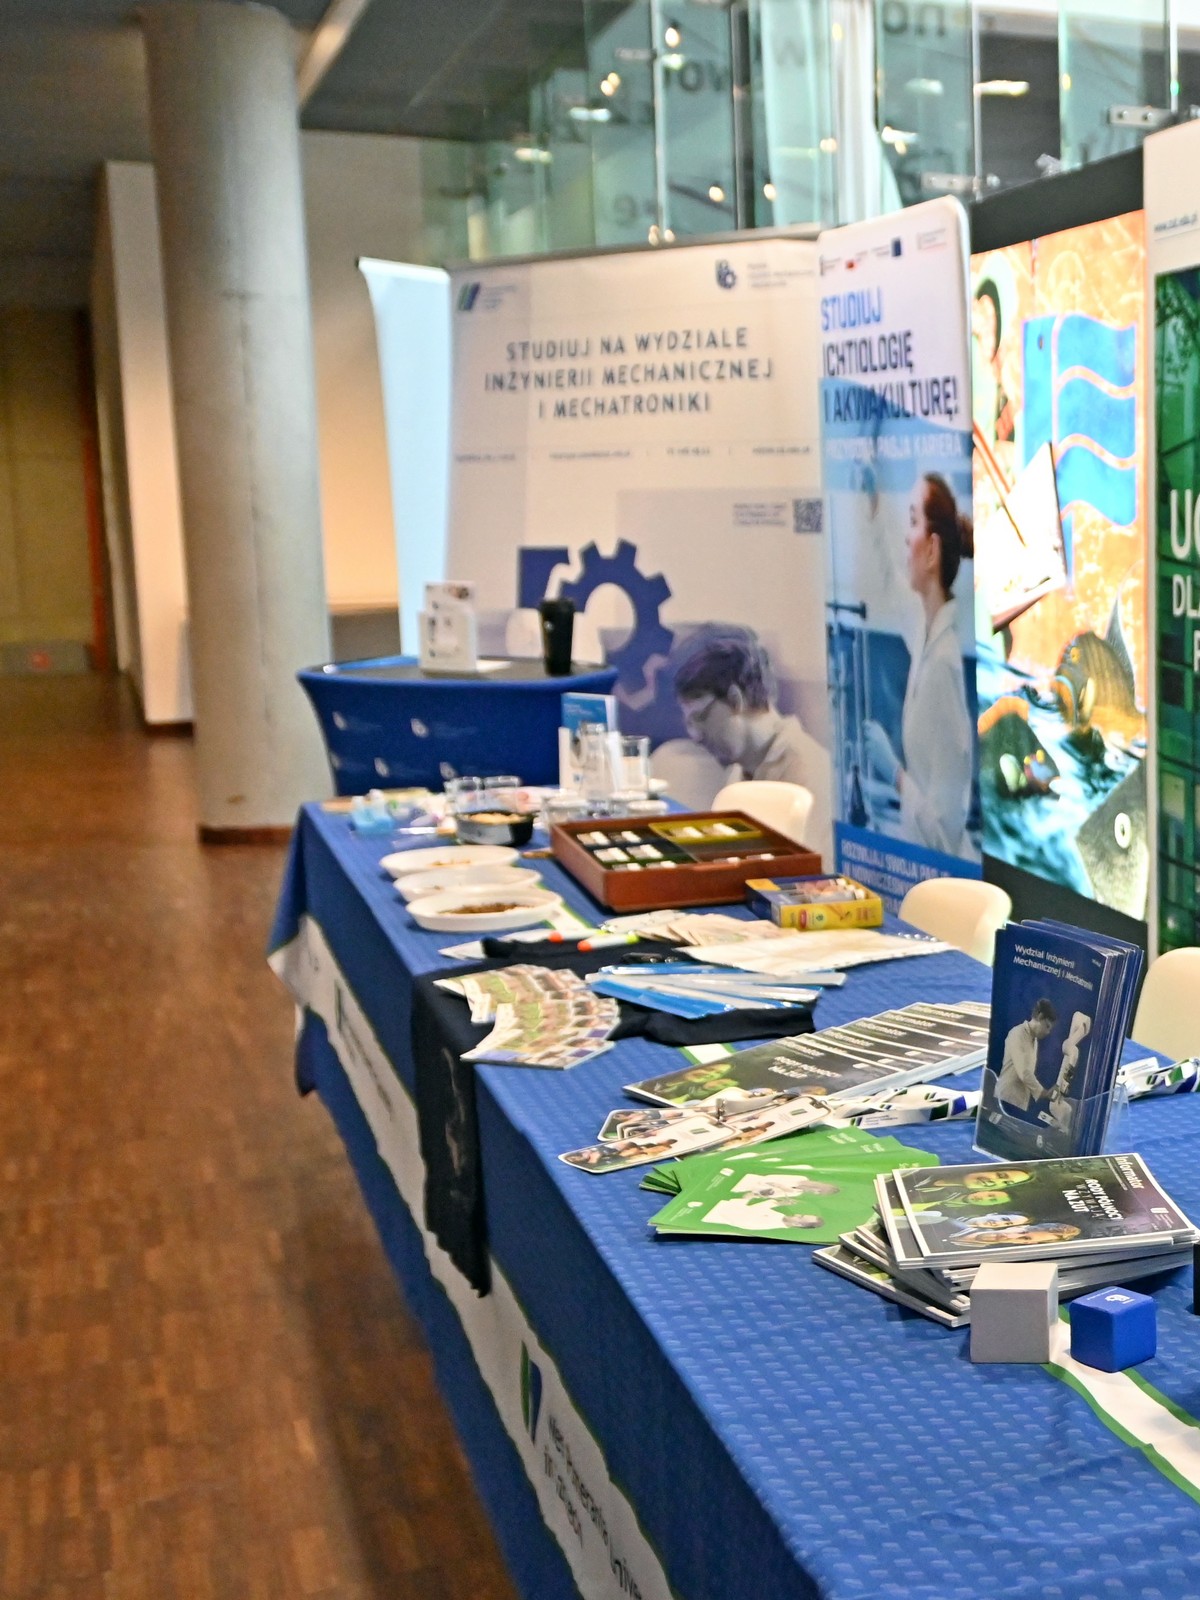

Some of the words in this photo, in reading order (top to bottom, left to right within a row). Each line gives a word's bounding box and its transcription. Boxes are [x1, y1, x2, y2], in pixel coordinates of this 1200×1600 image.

[821, 286, 882, 331] STUDIUJ
[505, 337, 591, 362] STUDIUJ
[600, 334, 626, 355] NA
[635, 327, 749, 352] WYDZIALE
[822, 330, 914, 377] ICHTIOLOGIĘ
[484, 367, 593, 392] INŻYNIERII
[602, 357, 775, 386] MECHANICZNEJ
[538, 399, 545, 419] I
[553, 391, 711, 419] MECHATRONIKI
[1013, 955, 1061, 978] Mechanicznej
[1014, 943, 1045, 959] Wydział
[1045, 951, 1075, 969] Inżynierii
[1114, 1155, 1145, 1190] Informator
[1062, 1189, 1081, 1201] NA
[1085, 1179, 1107, 1196] RODY
[1069, 1199, 1090, 1213] ZUT
